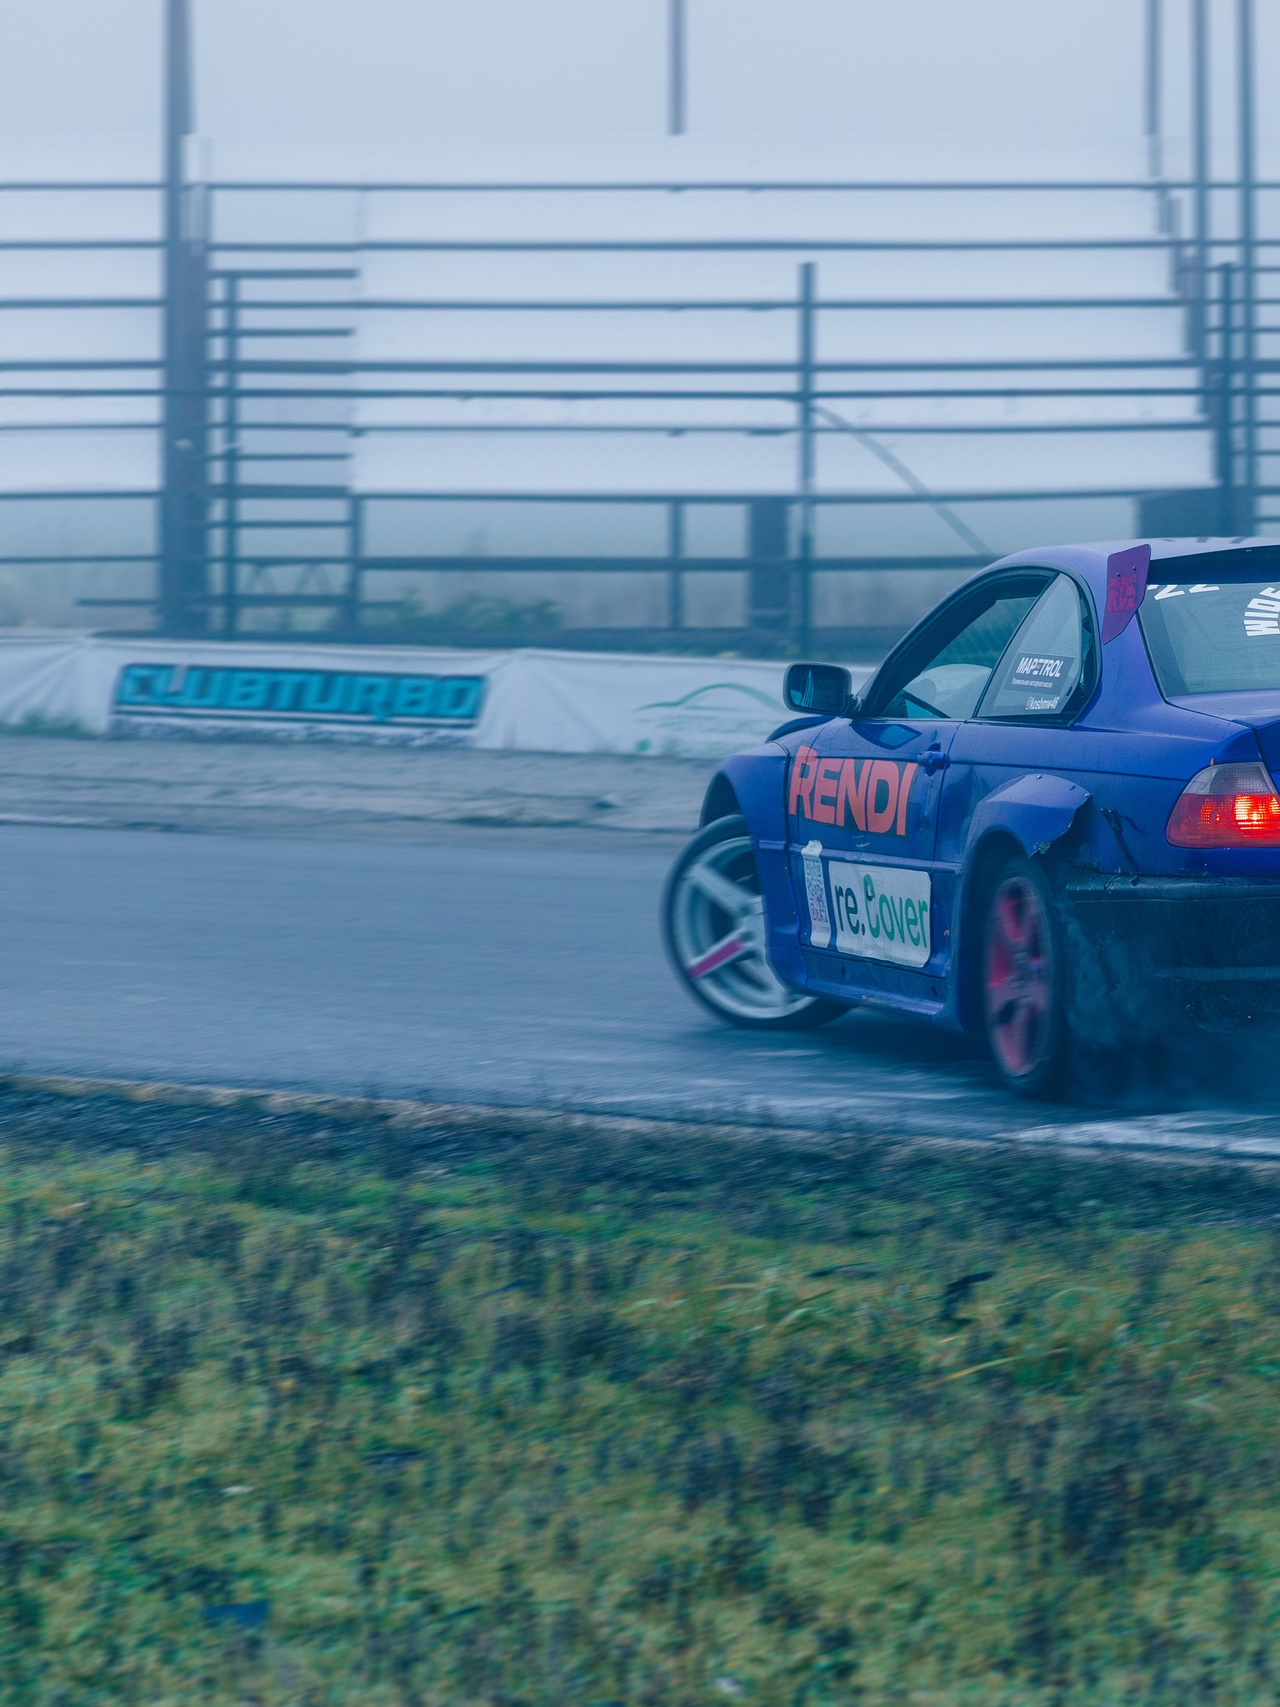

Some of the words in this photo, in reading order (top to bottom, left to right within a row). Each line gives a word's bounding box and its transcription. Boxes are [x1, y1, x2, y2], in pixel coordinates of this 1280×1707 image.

[118, 663, 486, 722] CLUBTURBO
[1015, 657, 1064, 678] MAPETROL
[789, 745, 918, 836] RENDI
